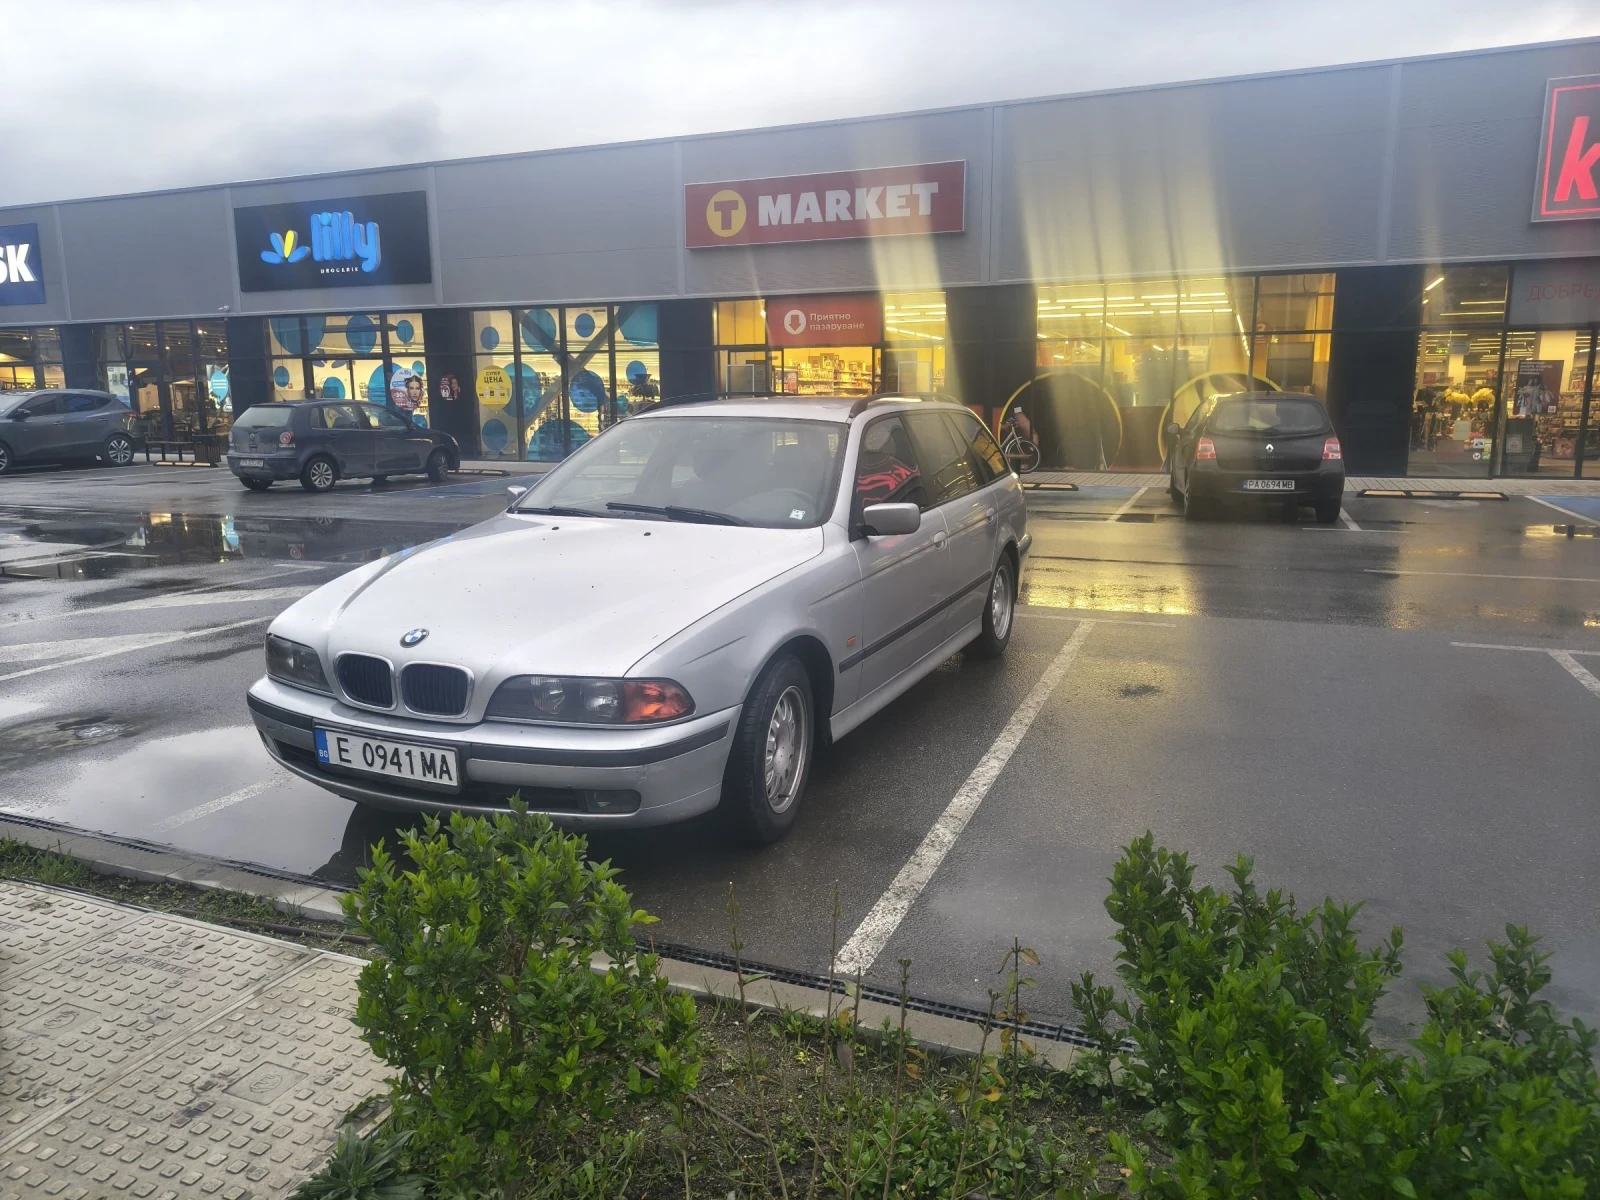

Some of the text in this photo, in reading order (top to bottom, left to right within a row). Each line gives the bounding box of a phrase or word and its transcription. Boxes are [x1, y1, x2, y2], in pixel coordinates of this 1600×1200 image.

[713, 181, 939, 231] T MARKET
[311, 210, 381, 273] lilly
[810, 313, 851, 322] Приятно
[810, 323, 865, 331] пазаруване
[483, 376, 504, 384] ЦЕНА
[1260, 480, 1281, 489] 0694
[318, 749, 329, 758] BG
[336, 736, 352, 764] E
[362, 741, 415, 776] 0941
